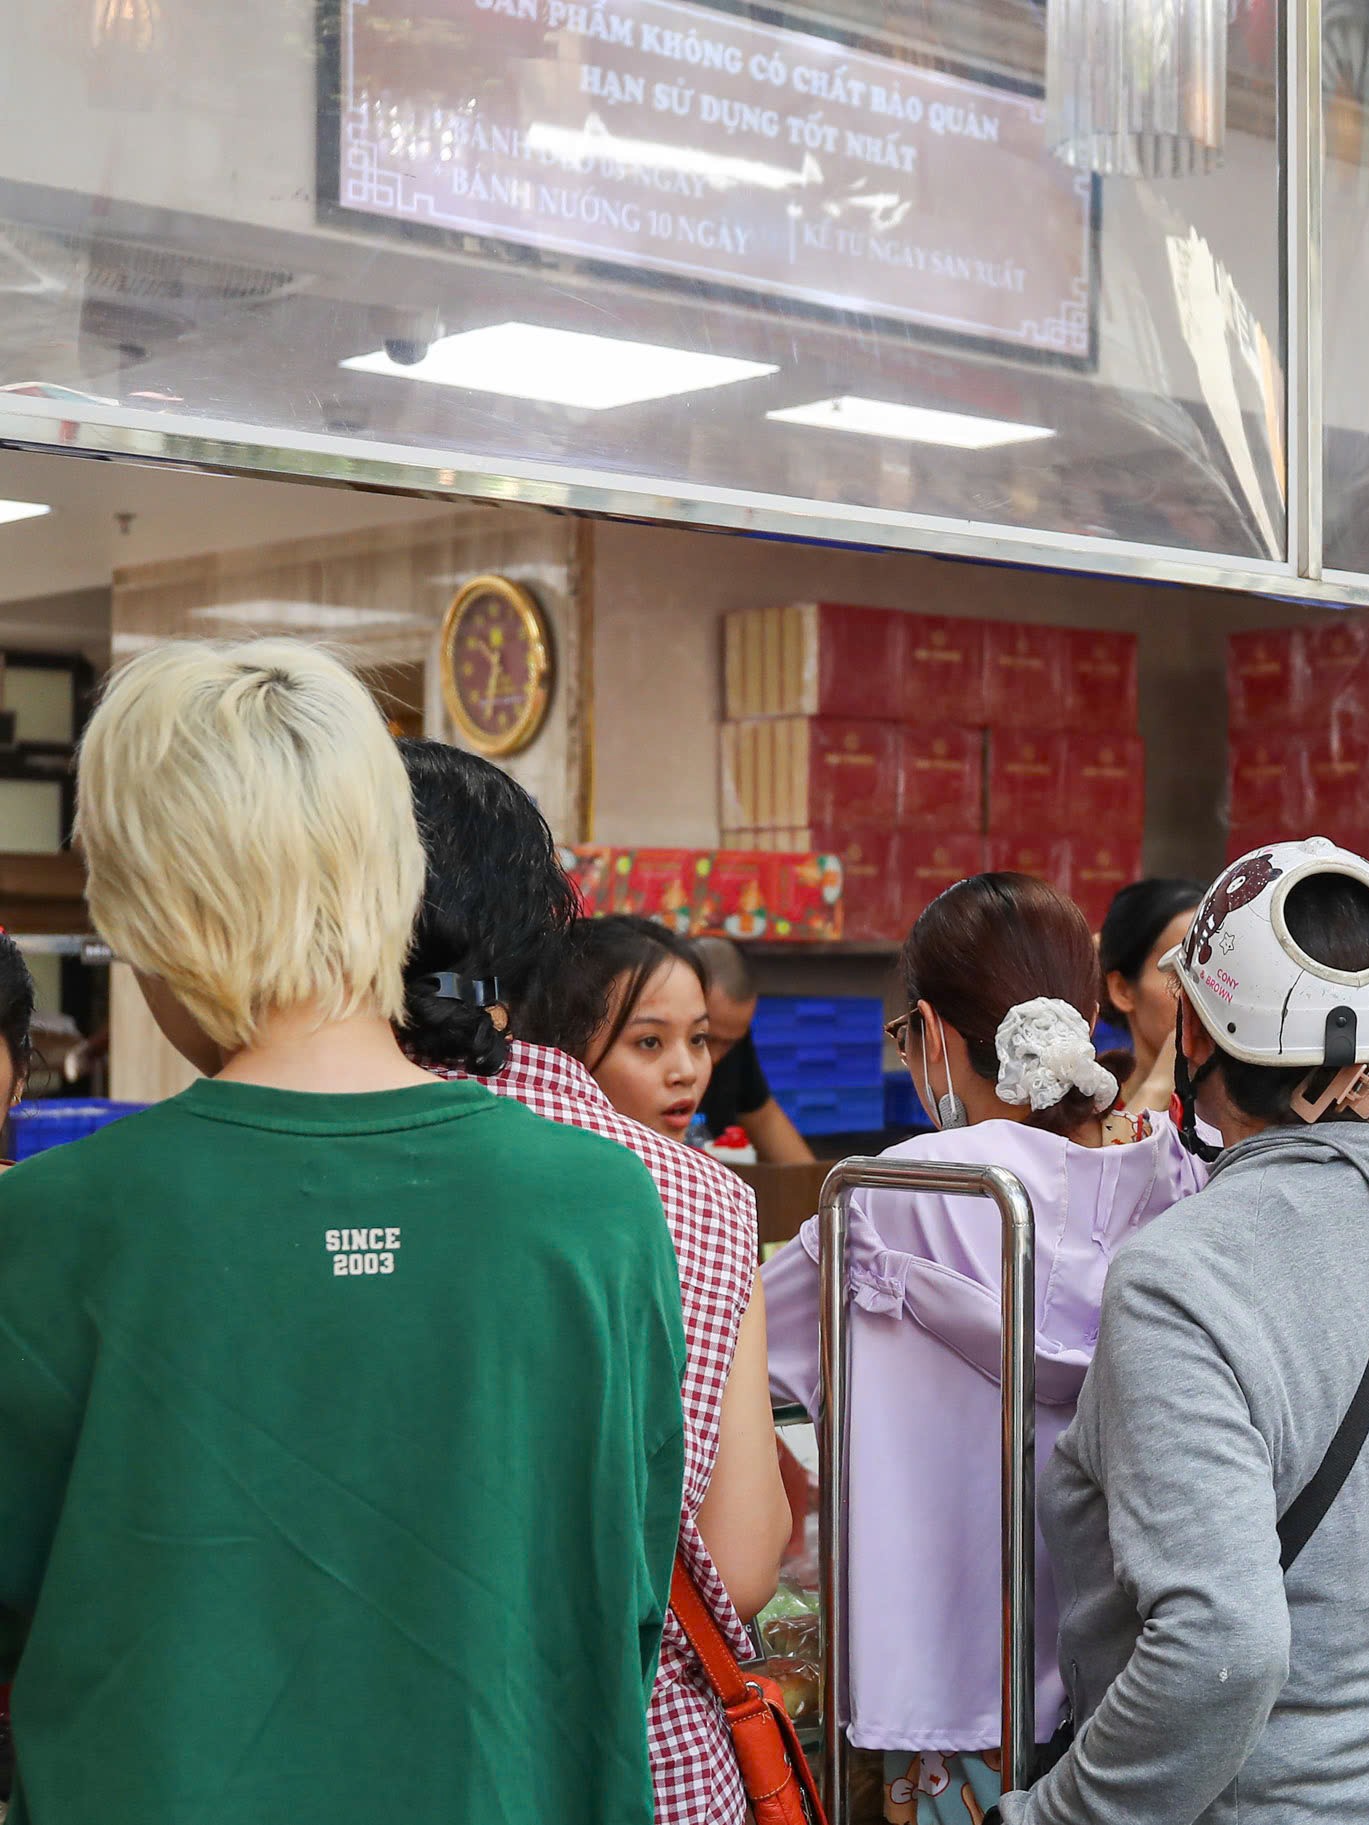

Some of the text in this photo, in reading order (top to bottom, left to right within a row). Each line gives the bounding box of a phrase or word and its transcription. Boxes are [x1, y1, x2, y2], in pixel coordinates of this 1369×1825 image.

[580, 64, 645, 105] HẠN
[699, 94, 779, 138] DỤNG
[787, 110, 839, 153] TỐT
[750, 52, 787, 87] CÓ
[793, 65, 867, 107] CHẤT
[870, 81, 923, 123] BẢO
[929, 102, 999, 142] QUẢN
[452, 163, 532, 210] BÁNH
[649, 210, 673, 238] 10
[1205, 975, 1233, 1003] BROWN
[1216, 968, 1239, 990] CONY
[325, 1227, 401, 1251] SINCE
[333, 1252, 395, 1276] 2003
